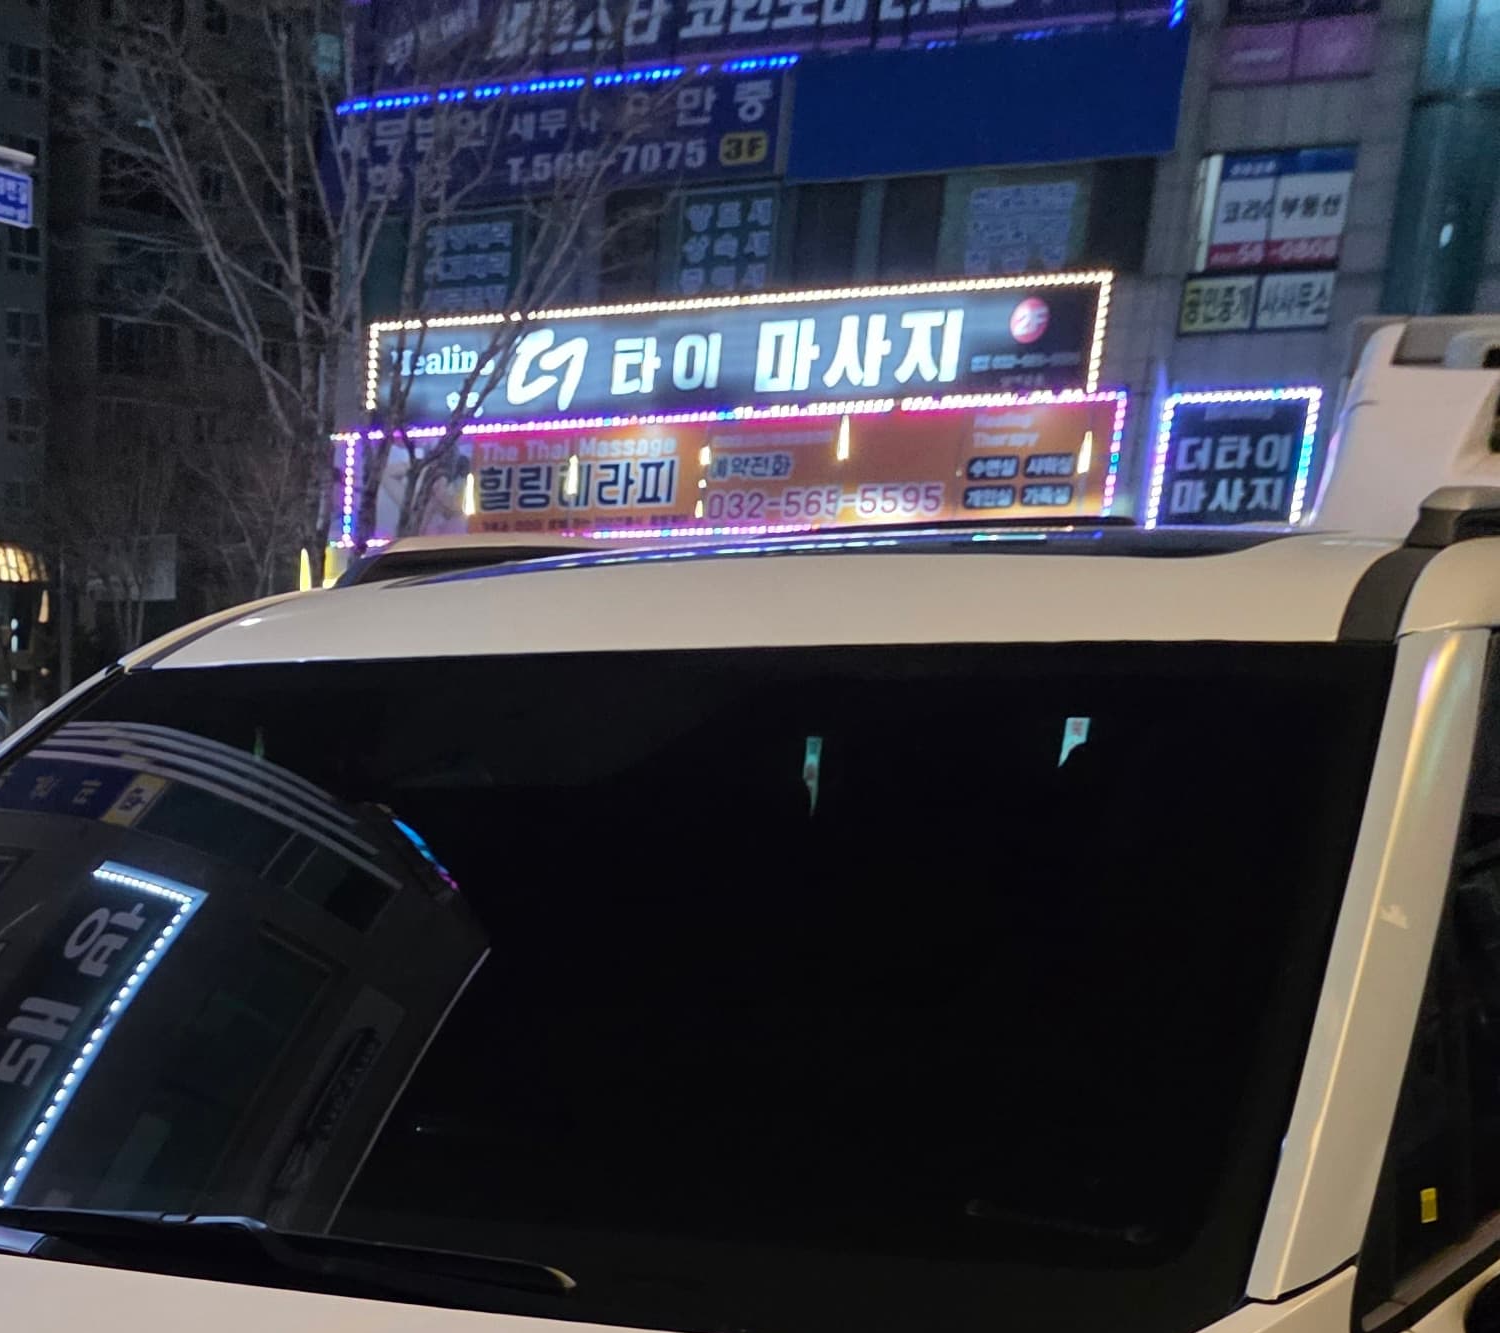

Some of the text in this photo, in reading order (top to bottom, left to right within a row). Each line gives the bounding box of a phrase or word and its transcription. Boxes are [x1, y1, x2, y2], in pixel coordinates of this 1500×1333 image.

[723, 137, 764, 161] 3F
[611, 333, 721, 395] 타이
[754, 308, 965, 394] 마사지
[1175, 434, 1293, 472] 더타이
[707, 483, 943, 520] 032-565-5595
[1169, 477, 1286, 515] 마사지
